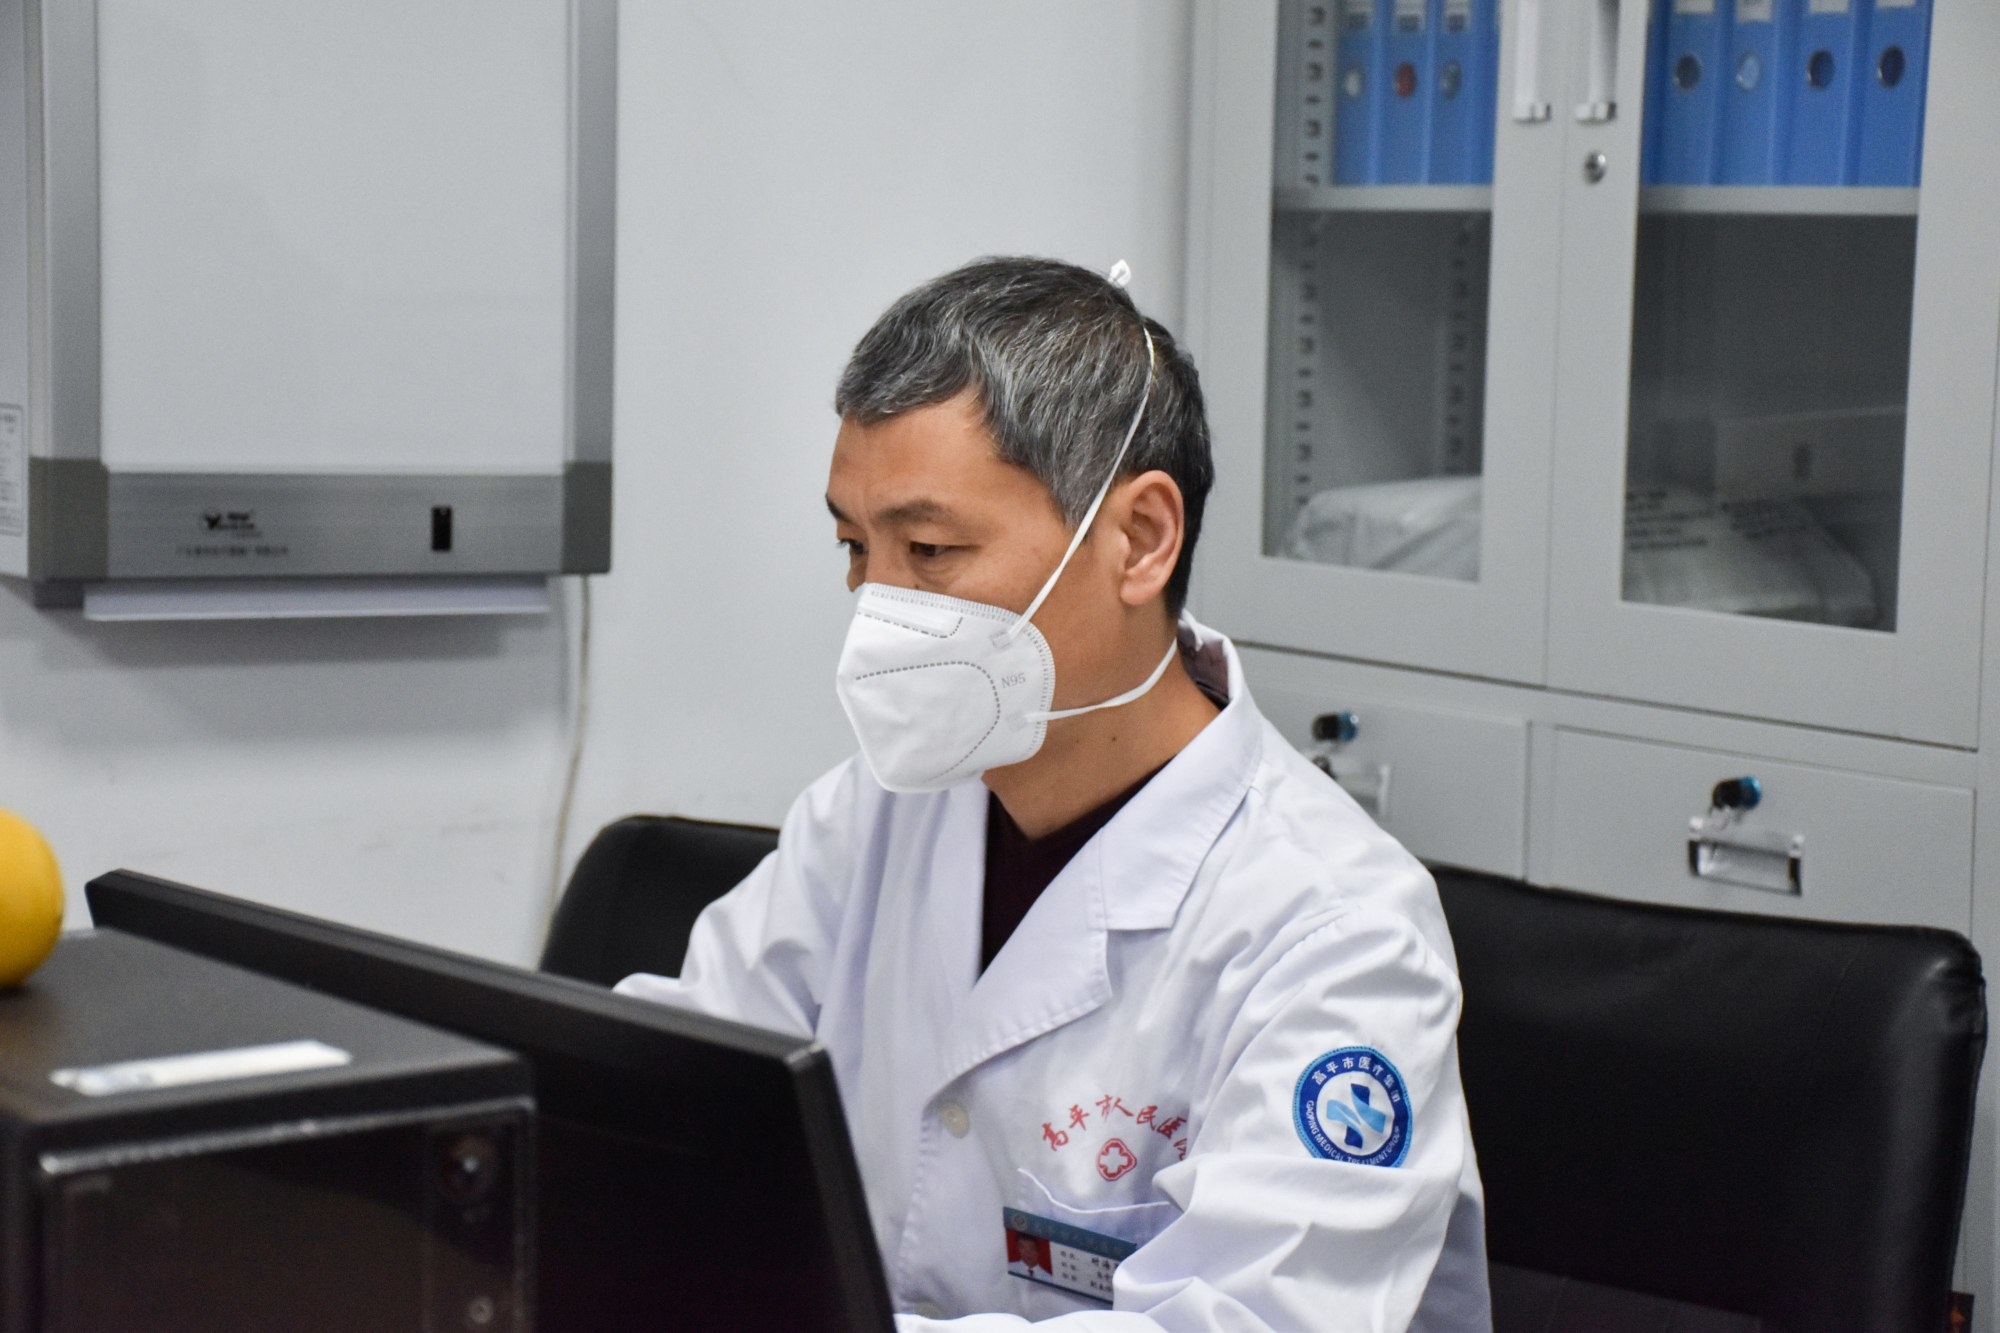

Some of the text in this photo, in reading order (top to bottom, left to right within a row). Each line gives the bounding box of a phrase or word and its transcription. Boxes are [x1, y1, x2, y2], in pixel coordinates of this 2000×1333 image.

[1001, 672, 1026, 688] N95
[1305, 1100, 1319, 1135] GAOPING
[1314, 1134, 1344, 1161] MEDICAL
